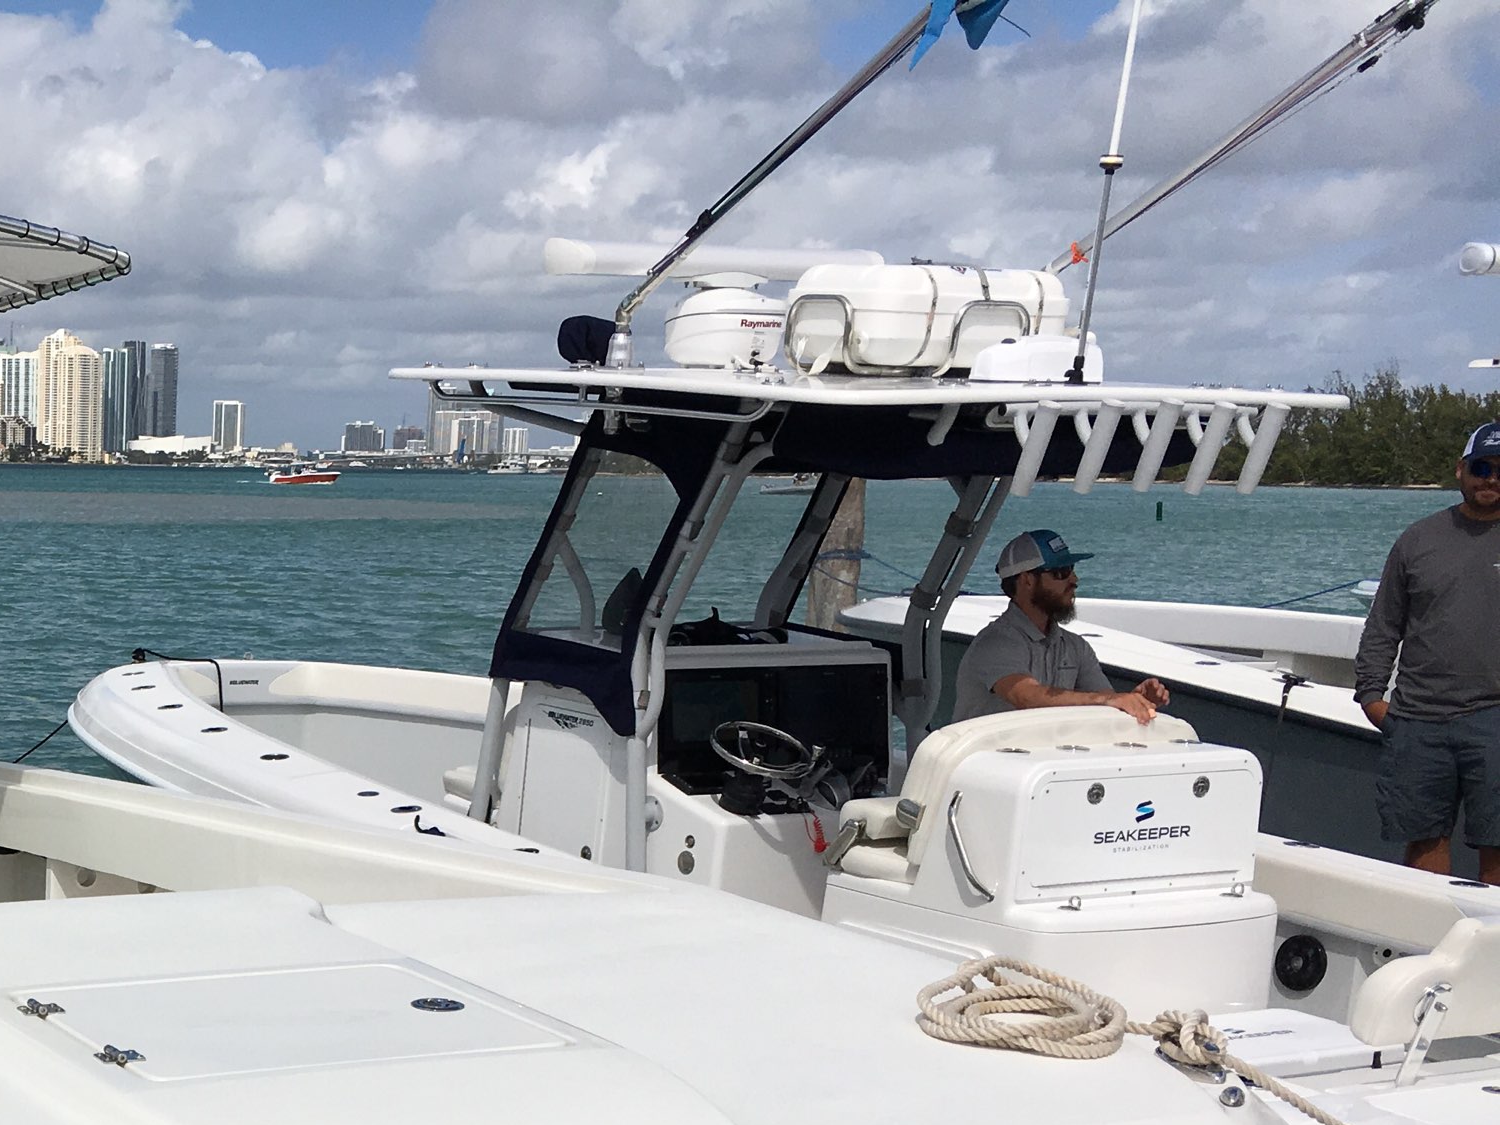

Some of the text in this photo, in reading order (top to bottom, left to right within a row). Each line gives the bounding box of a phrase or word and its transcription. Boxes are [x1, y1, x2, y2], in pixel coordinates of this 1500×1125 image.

[740, 319, 782, 329] Raymarine
[1093, 825, 1191, 844] SEAKEEPER
[1113, 844, 1169, 853] STABILIZATION
